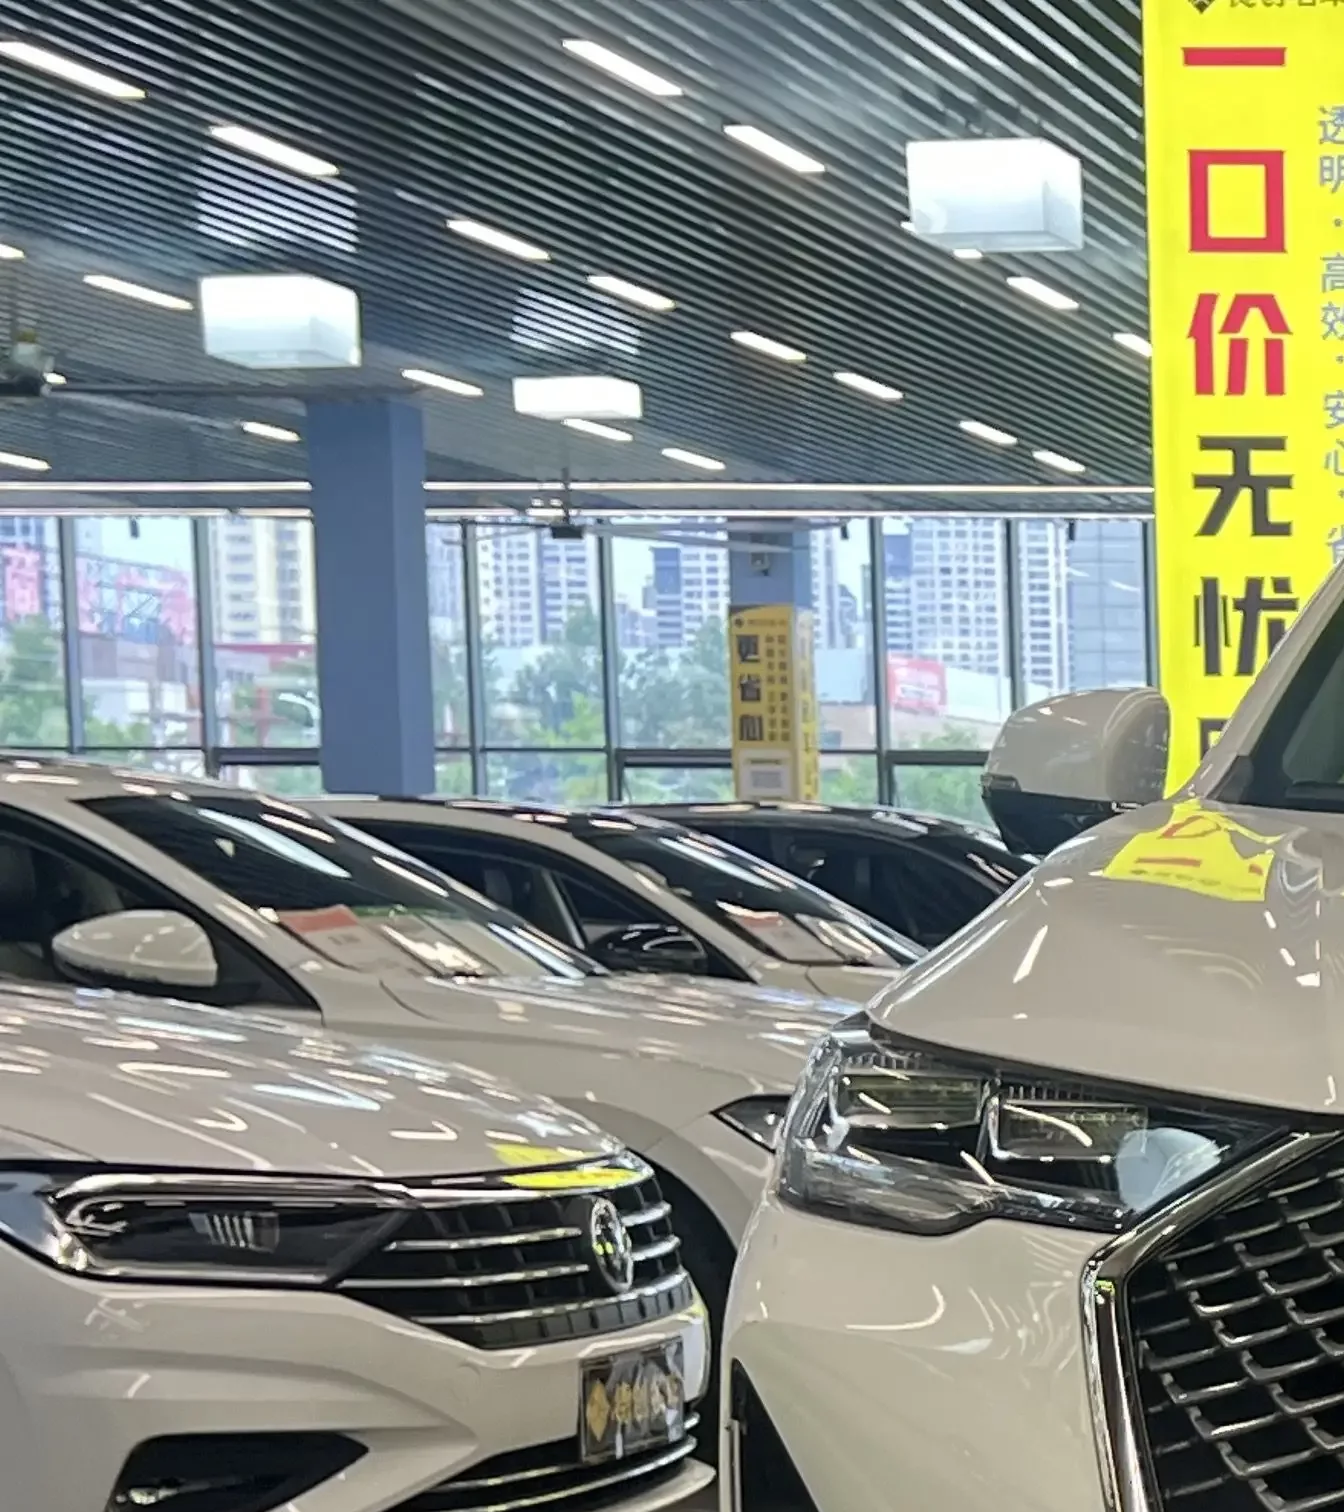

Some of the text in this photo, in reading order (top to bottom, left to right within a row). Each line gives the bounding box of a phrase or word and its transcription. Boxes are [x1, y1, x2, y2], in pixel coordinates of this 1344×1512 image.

[1181, 47, 1299, 763] 一口价无忧
